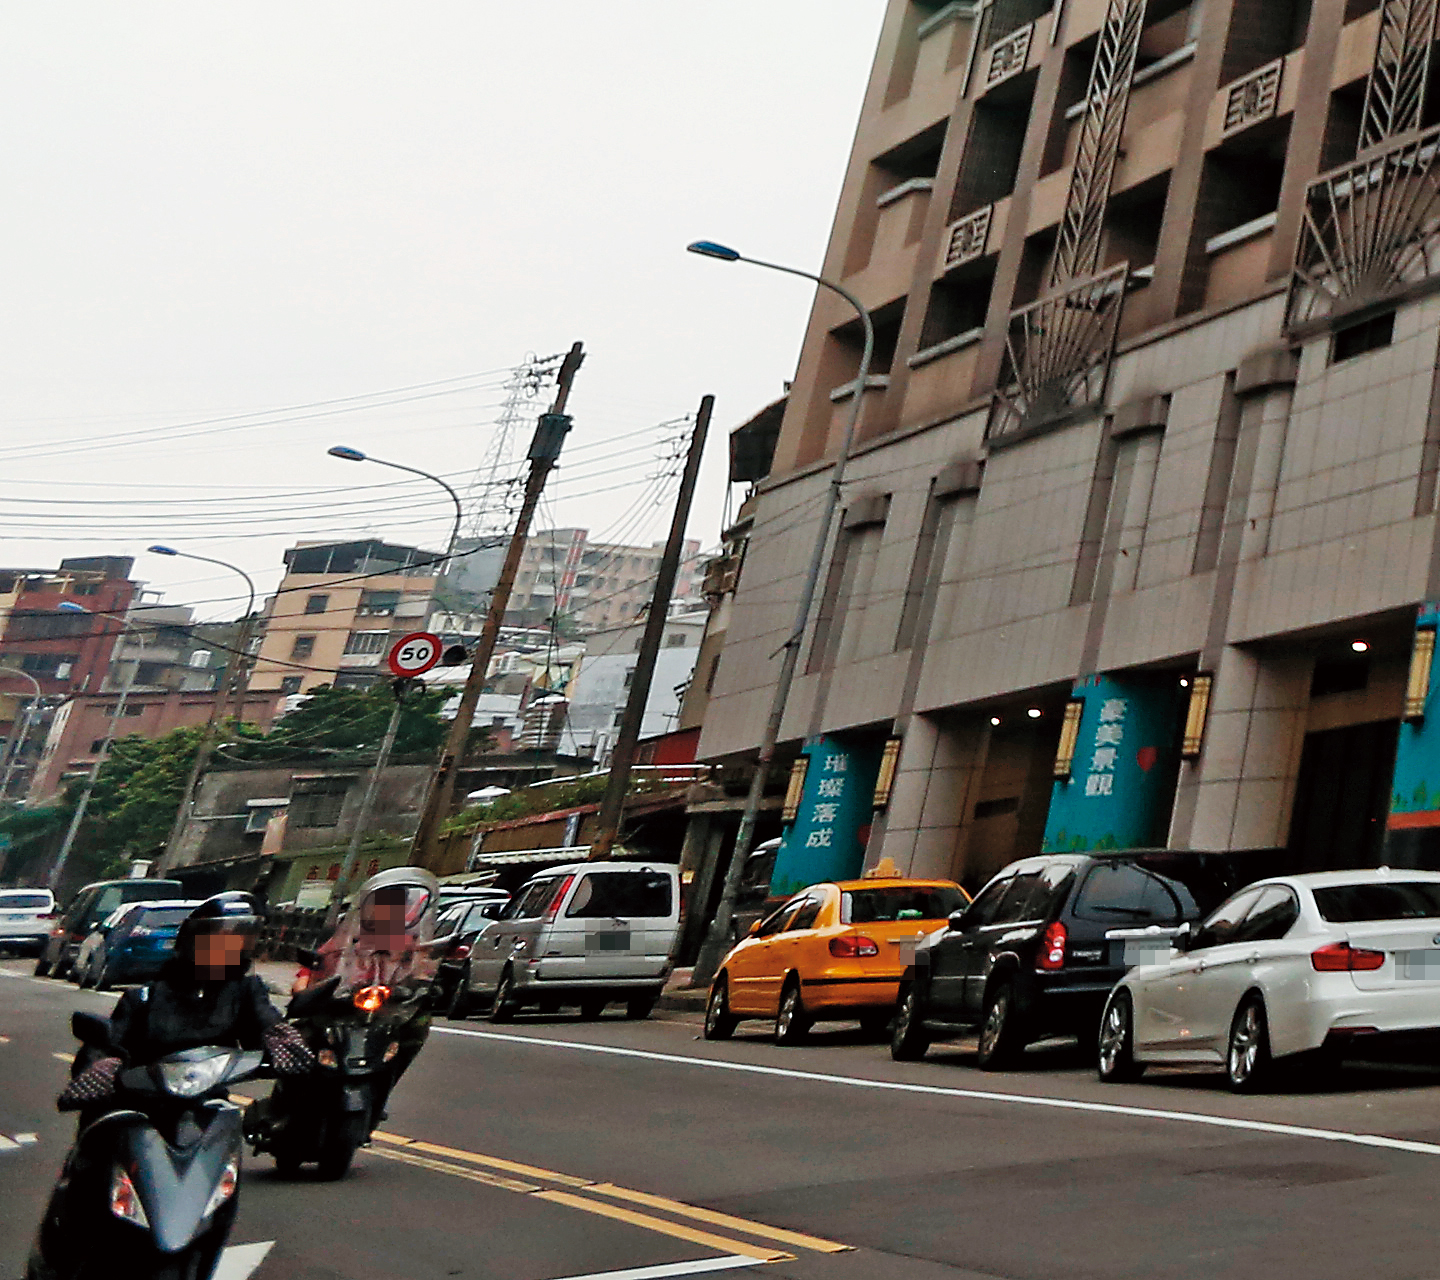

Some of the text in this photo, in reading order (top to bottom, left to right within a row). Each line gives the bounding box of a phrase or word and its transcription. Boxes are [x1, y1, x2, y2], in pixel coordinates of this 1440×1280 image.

[401, 647, 429, 660] 50
[805, 753, 848, 848] 璀璨落成
